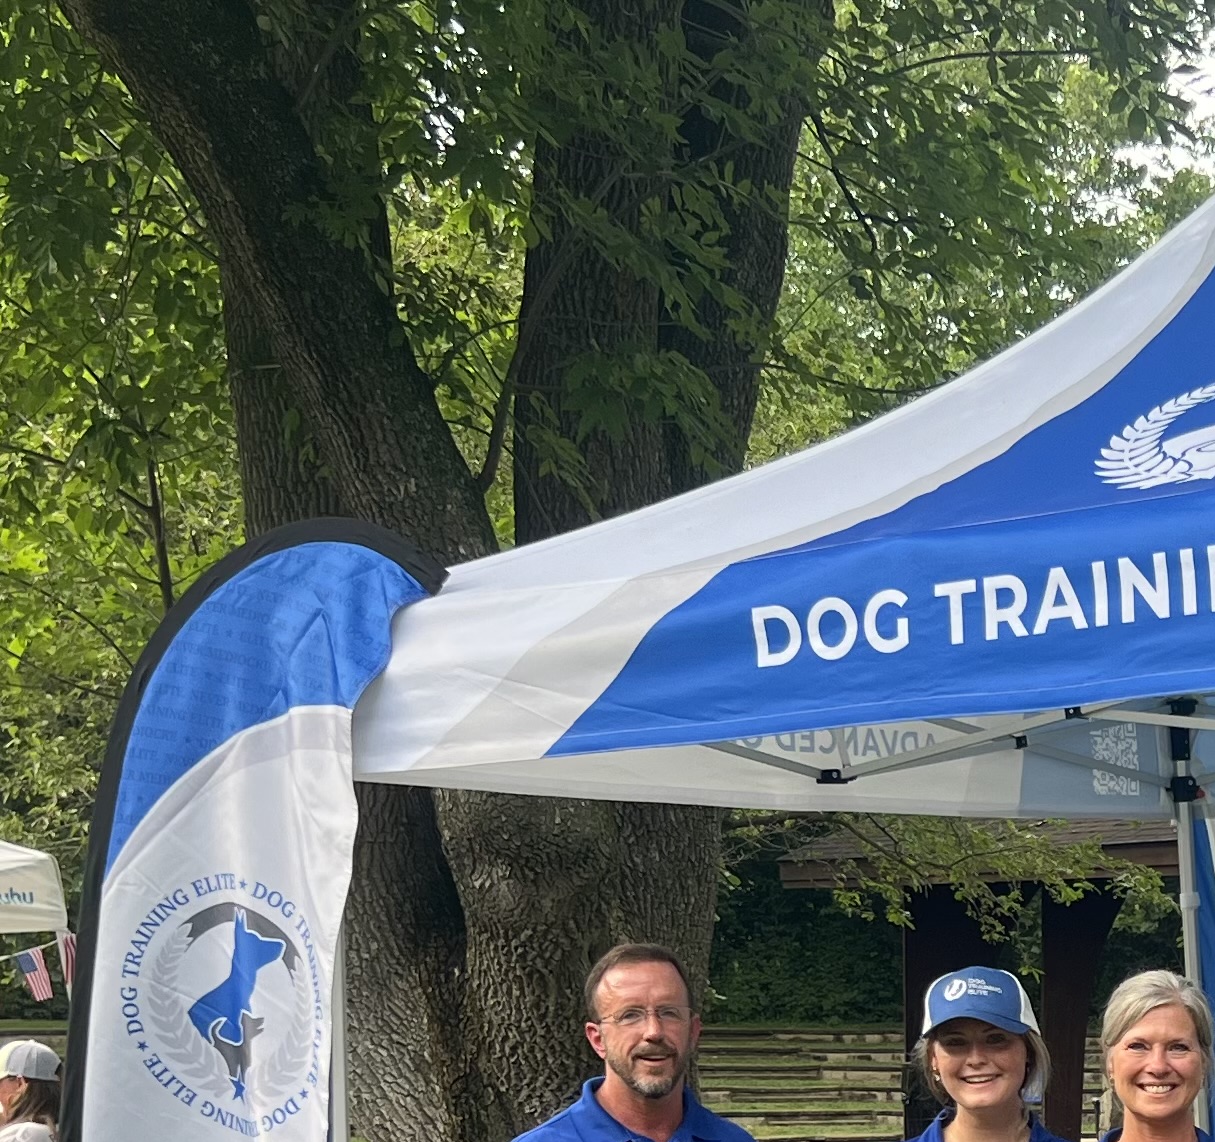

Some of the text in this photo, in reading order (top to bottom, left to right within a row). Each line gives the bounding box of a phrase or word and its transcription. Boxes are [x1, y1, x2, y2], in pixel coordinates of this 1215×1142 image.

[750, 586, 911, 669] DOG
[251, 881, 296, 919] DOG
[120, 873, 236, 1036] DOG TRAINING ELITE
[142, 1052, 198, 1107] ELITE
[262, 1097, 301, 1131] DOG
